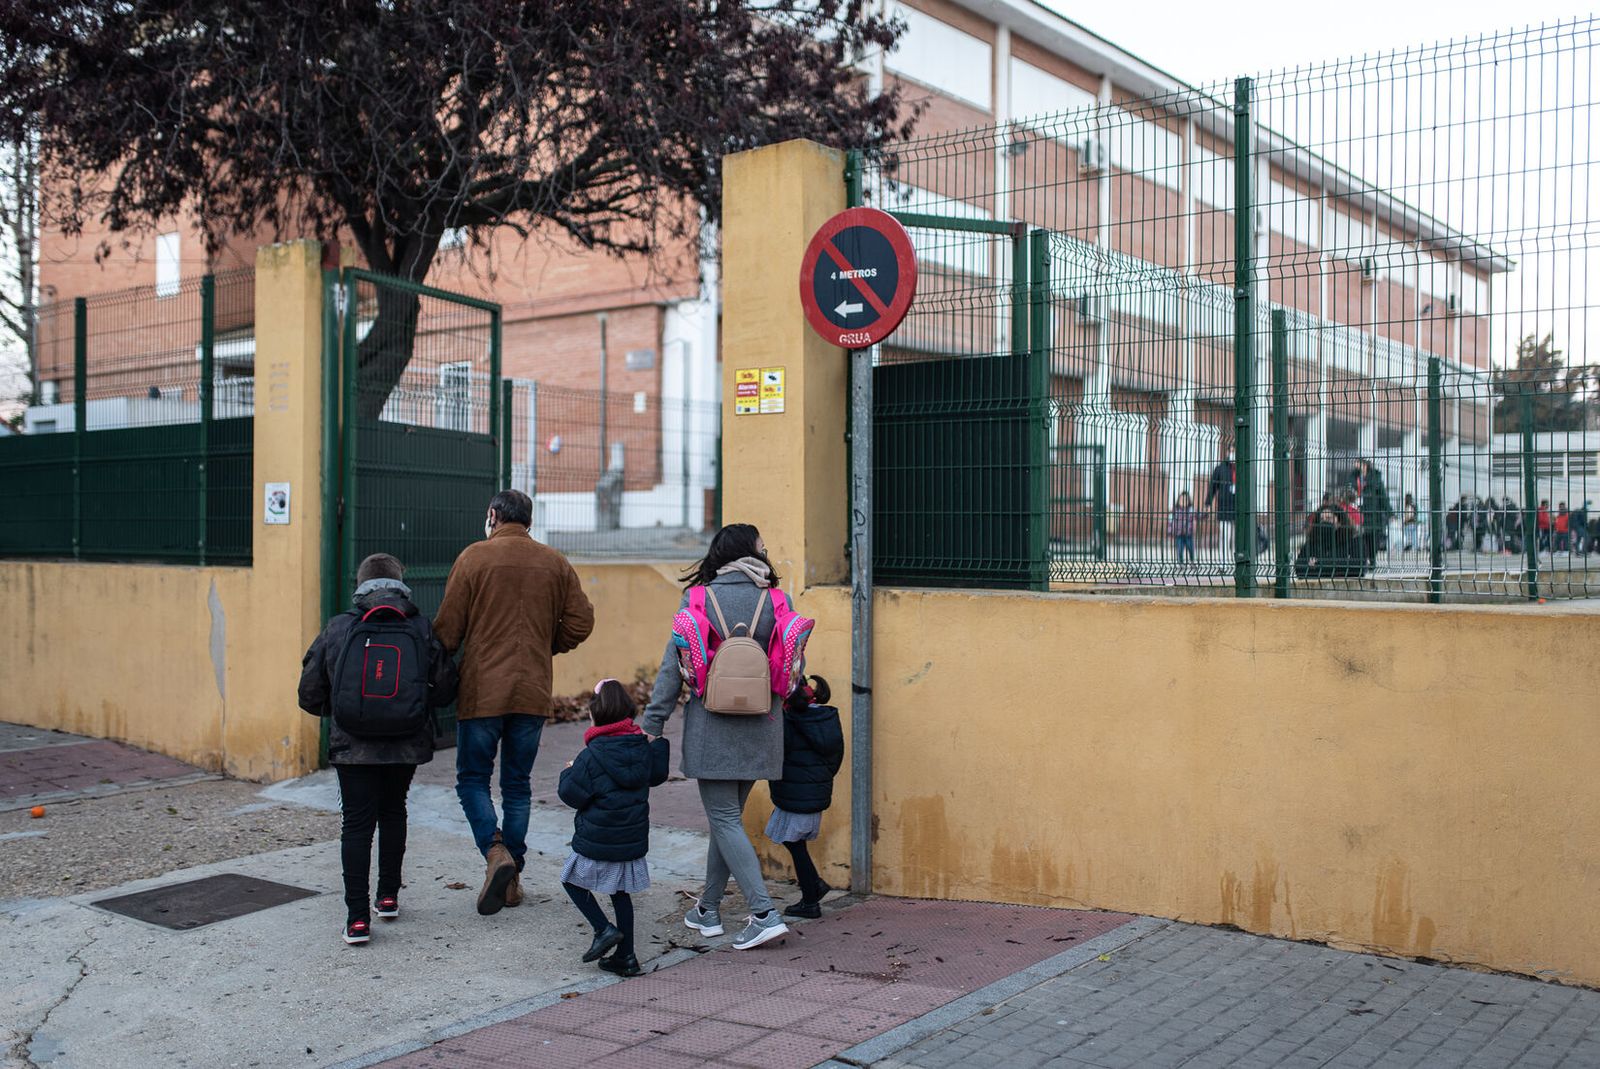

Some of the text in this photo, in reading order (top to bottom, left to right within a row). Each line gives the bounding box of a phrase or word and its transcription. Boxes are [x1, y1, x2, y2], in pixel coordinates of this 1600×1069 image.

[830, 268, 877, 280] 4 METROS
[839, 332, 871, 344] GRUA
